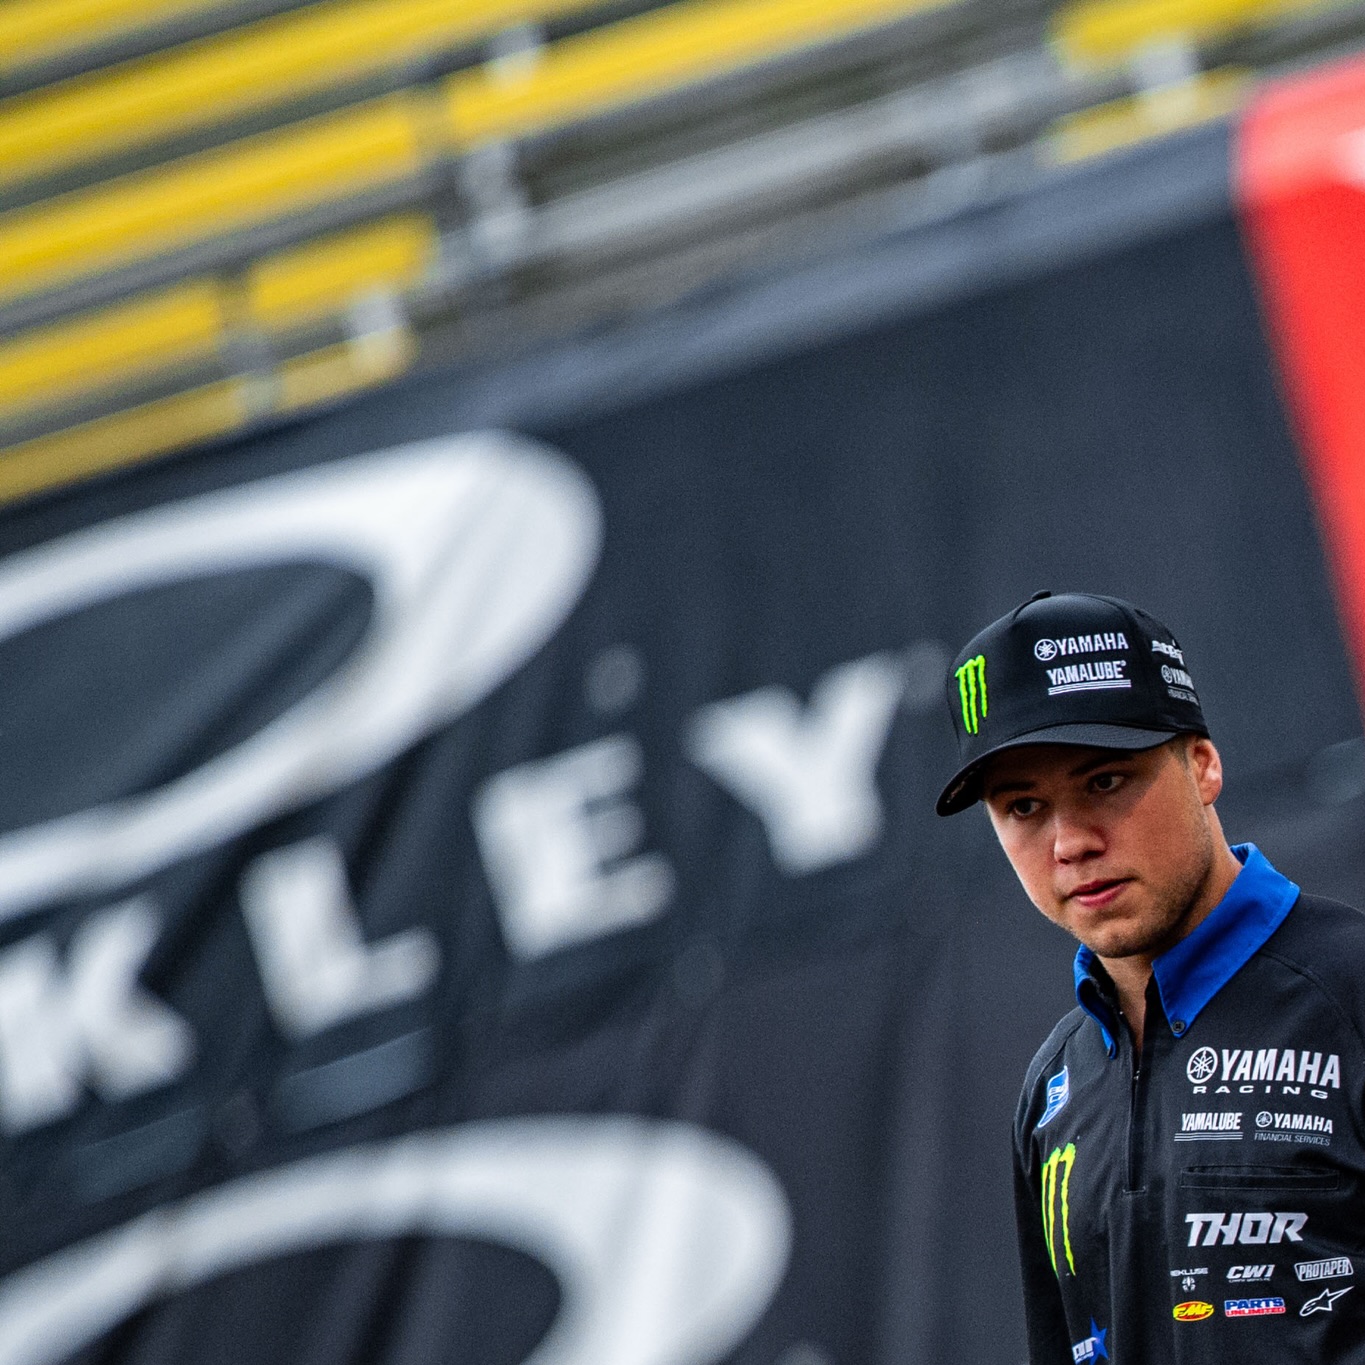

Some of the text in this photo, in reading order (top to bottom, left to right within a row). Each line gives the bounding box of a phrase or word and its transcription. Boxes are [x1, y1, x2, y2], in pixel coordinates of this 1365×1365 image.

[1056, 632, 1129, 656] YAMAHA
[1047, 660, 1124, 685] YAMALUBE
[1221, 1049, 1340, 1089] YAMAHA
[1193, 1085, 1329, 1099] RACING
[1181, 1112, 1243, 1131] YAMALUBE
[1274, 1112, 1334, 1134] YAMAHA
[1254, 1132, 1330, 1146] FINANCIAL SERVICES
[1185, 1212, 1309, 1247] THOR
[1225, 1298, 1285, 1310] PARTS
[1225, 1307, 1286, 1317] UNLIMITED
